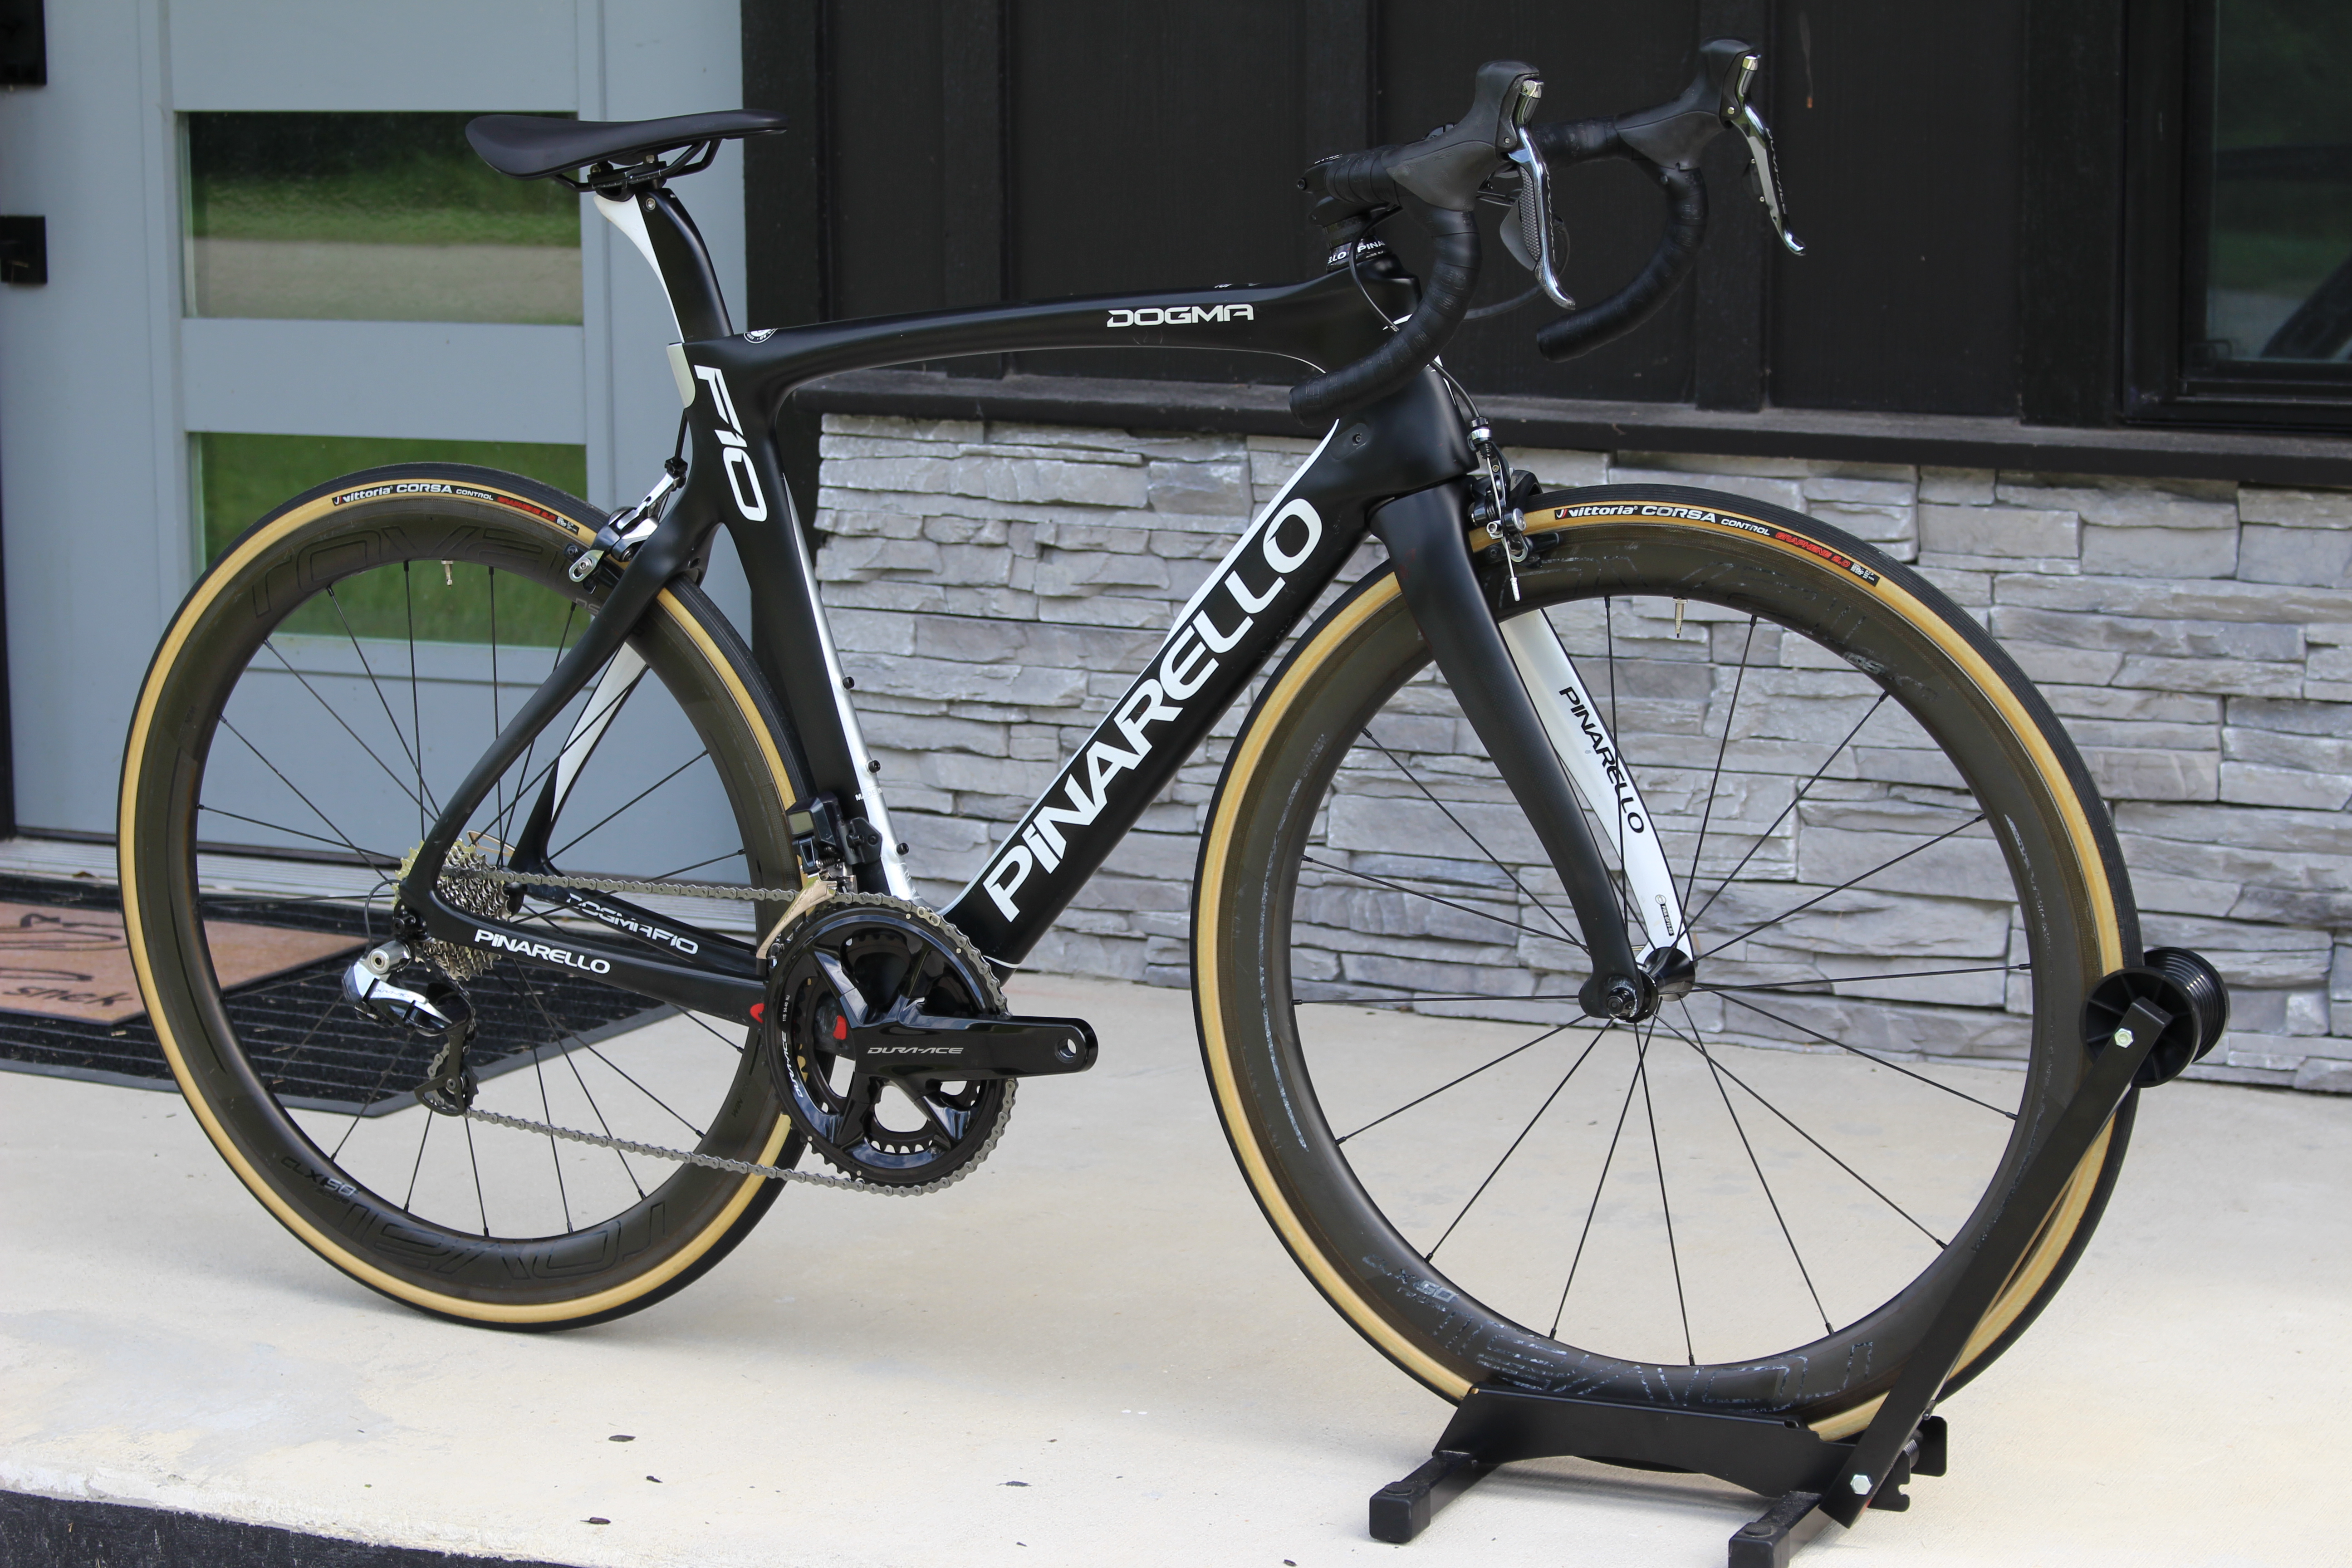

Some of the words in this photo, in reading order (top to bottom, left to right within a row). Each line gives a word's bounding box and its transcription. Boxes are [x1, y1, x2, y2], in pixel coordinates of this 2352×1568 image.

[1107, 304, 1254, 328] DOGMA
[694, 365, 767, 521] F10
[342, 487, 392, 503] vittoria
[396, 484, 452, 494] CORSA
[456, 489, 494, 500] CONTROL
[1568, 505, 1634, 517] vittoria
[1641, 505, 1716, 523] CORSA
[1720, 518, 1770, 536] CONTROL
[1775, 531, 1833, 559] GRAPHENE
[1831, 555, 1851, 568] 2.0
[983, 498, 1323, 922] PINARELLO
[1559, 686, 1645, 834] PINARELLO
[474, 929, 611, 974] PINARELLO
[782, 1030, 804, 1098] DURA-ACE
[280, 1156, 323, 1182] CLX
